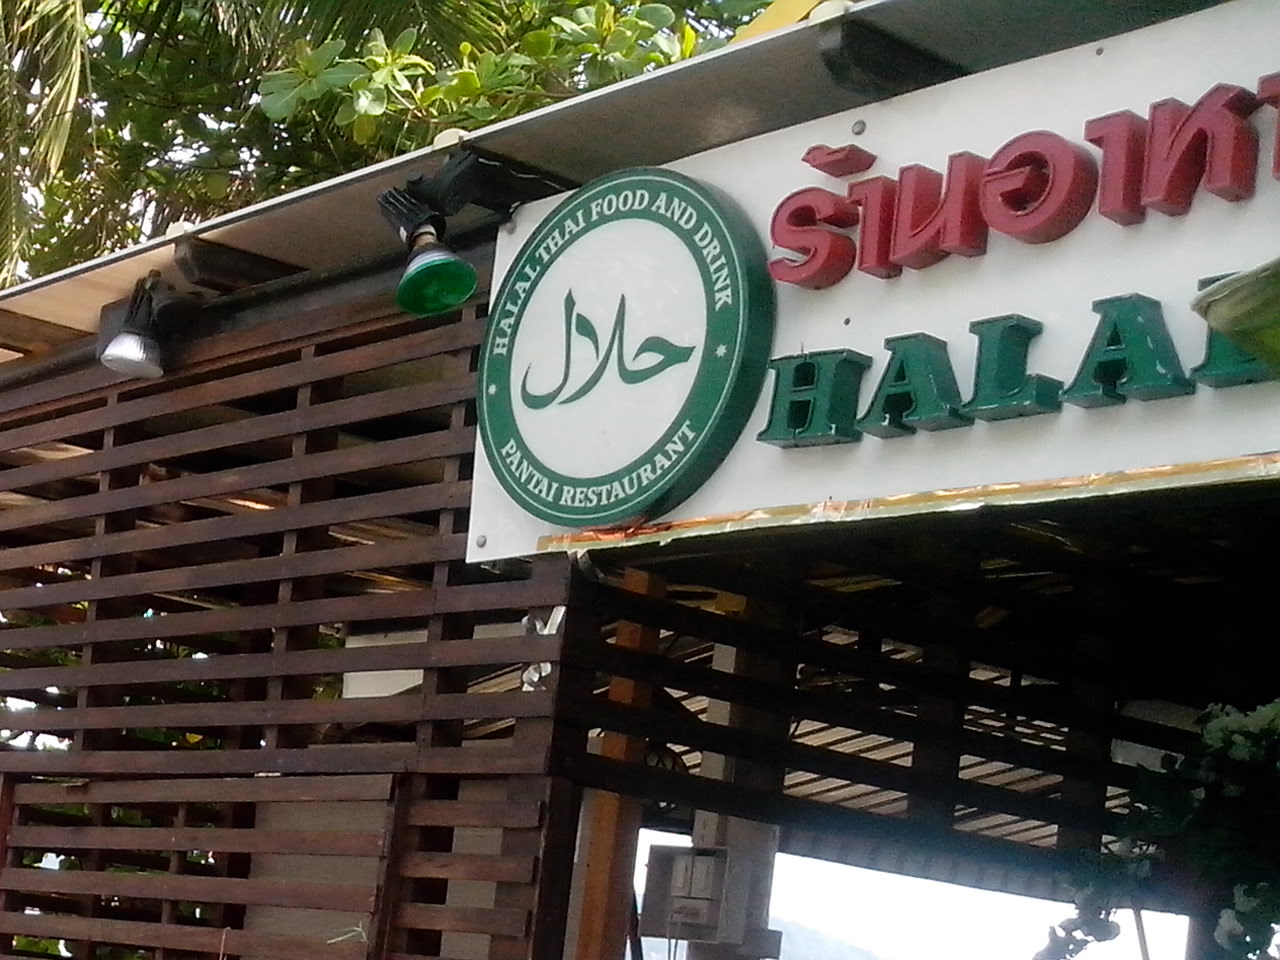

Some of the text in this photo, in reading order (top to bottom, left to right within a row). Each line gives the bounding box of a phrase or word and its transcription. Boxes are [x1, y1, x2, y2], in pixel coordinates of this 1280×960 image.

[493, 189, 733, 356] HALAL THAI FOOD AND DRINK
[500, 420, 696, 508] PANTAI RESTAURANT
